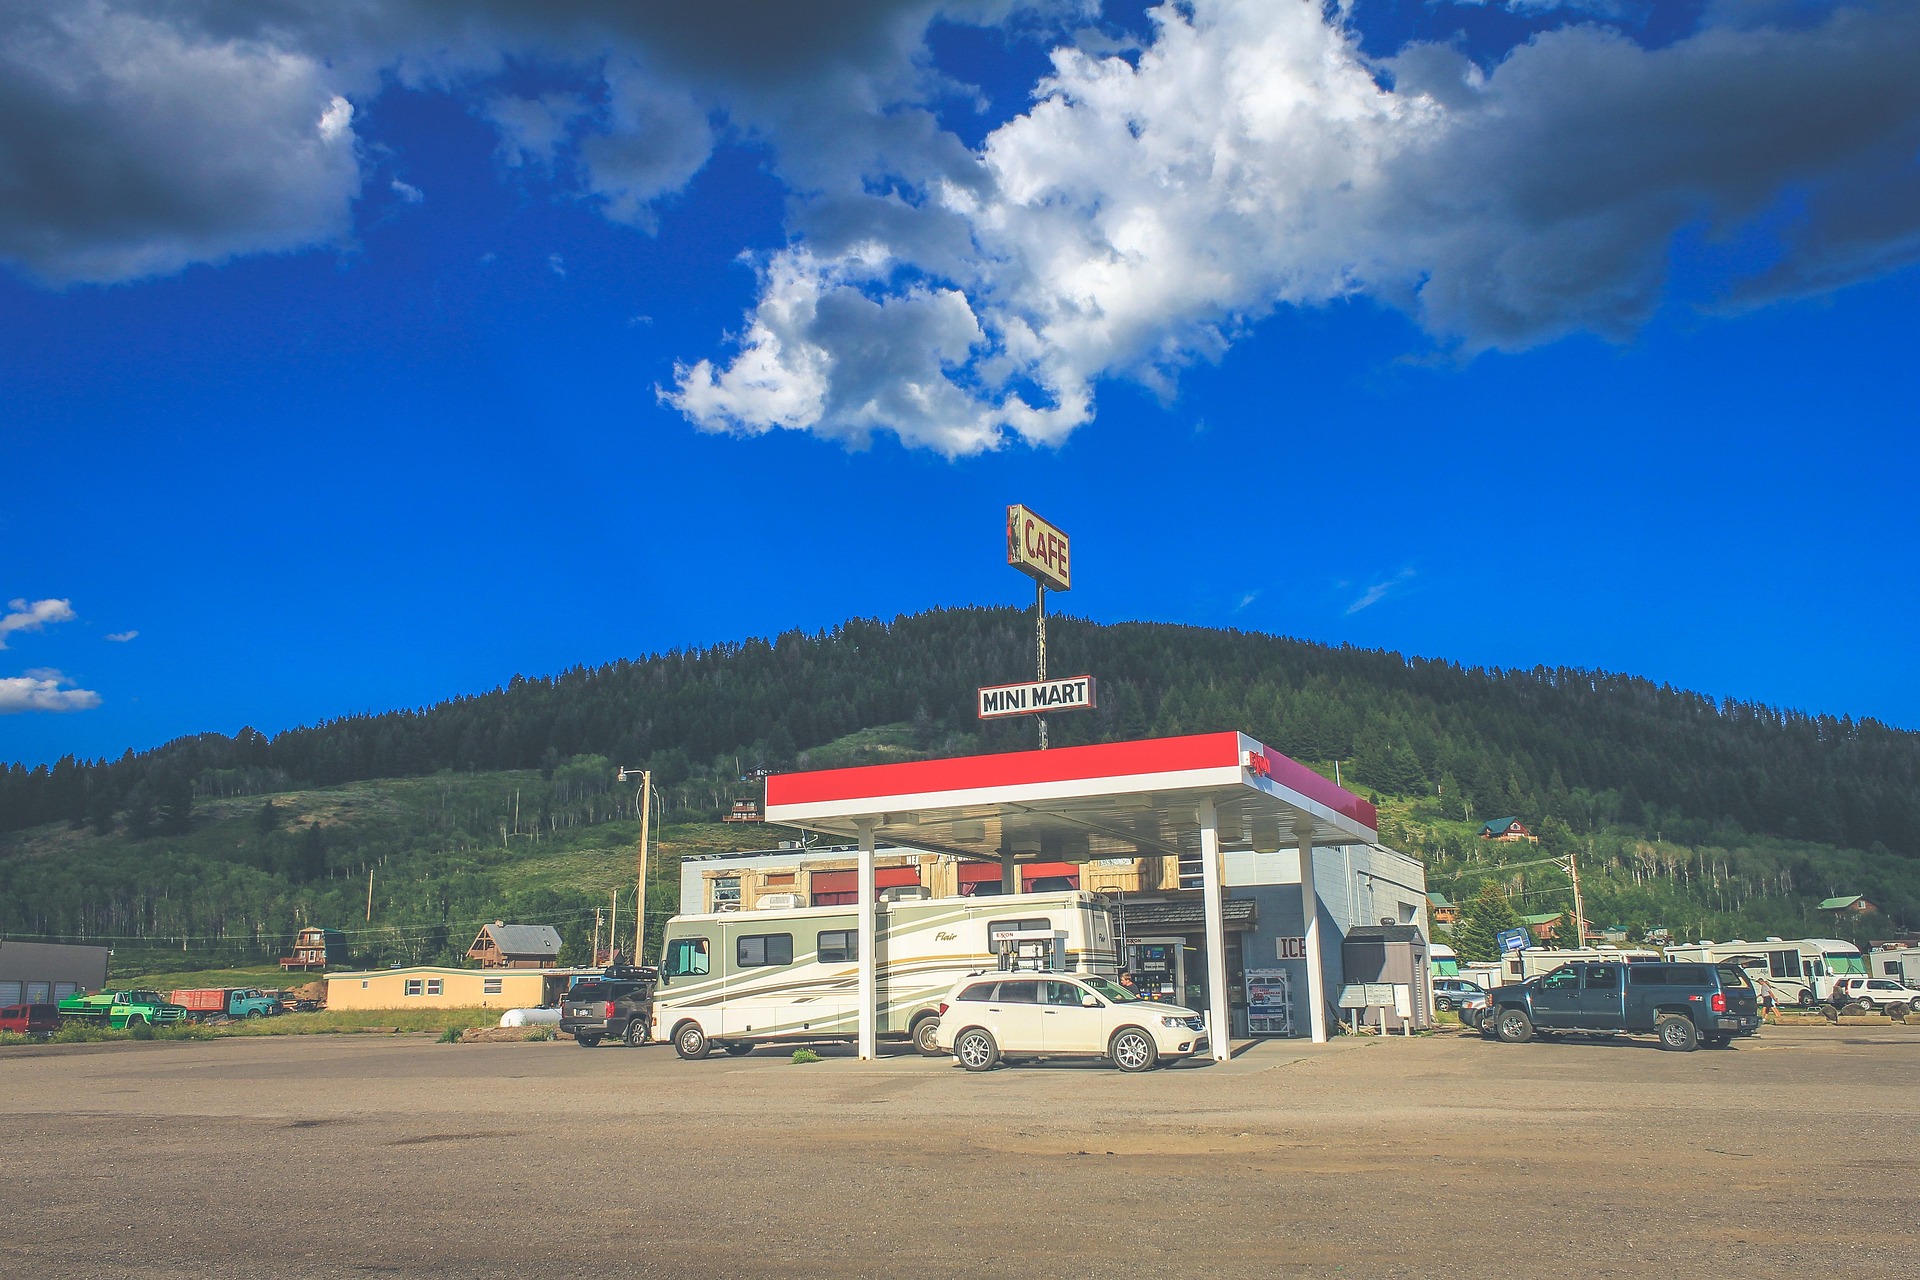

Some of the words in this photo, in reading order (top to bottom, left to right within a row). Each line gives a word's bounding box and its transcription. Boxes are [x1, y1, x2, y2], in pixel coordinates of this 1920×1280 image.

[1025, 519, 1067, 578] CAFE
[983, 688, 1026, 712] MINI
[1032, 682, 1086, 706] MART
[935, 931, 957, 941] Flair
[1281, 938, 1306, 957] ICE
